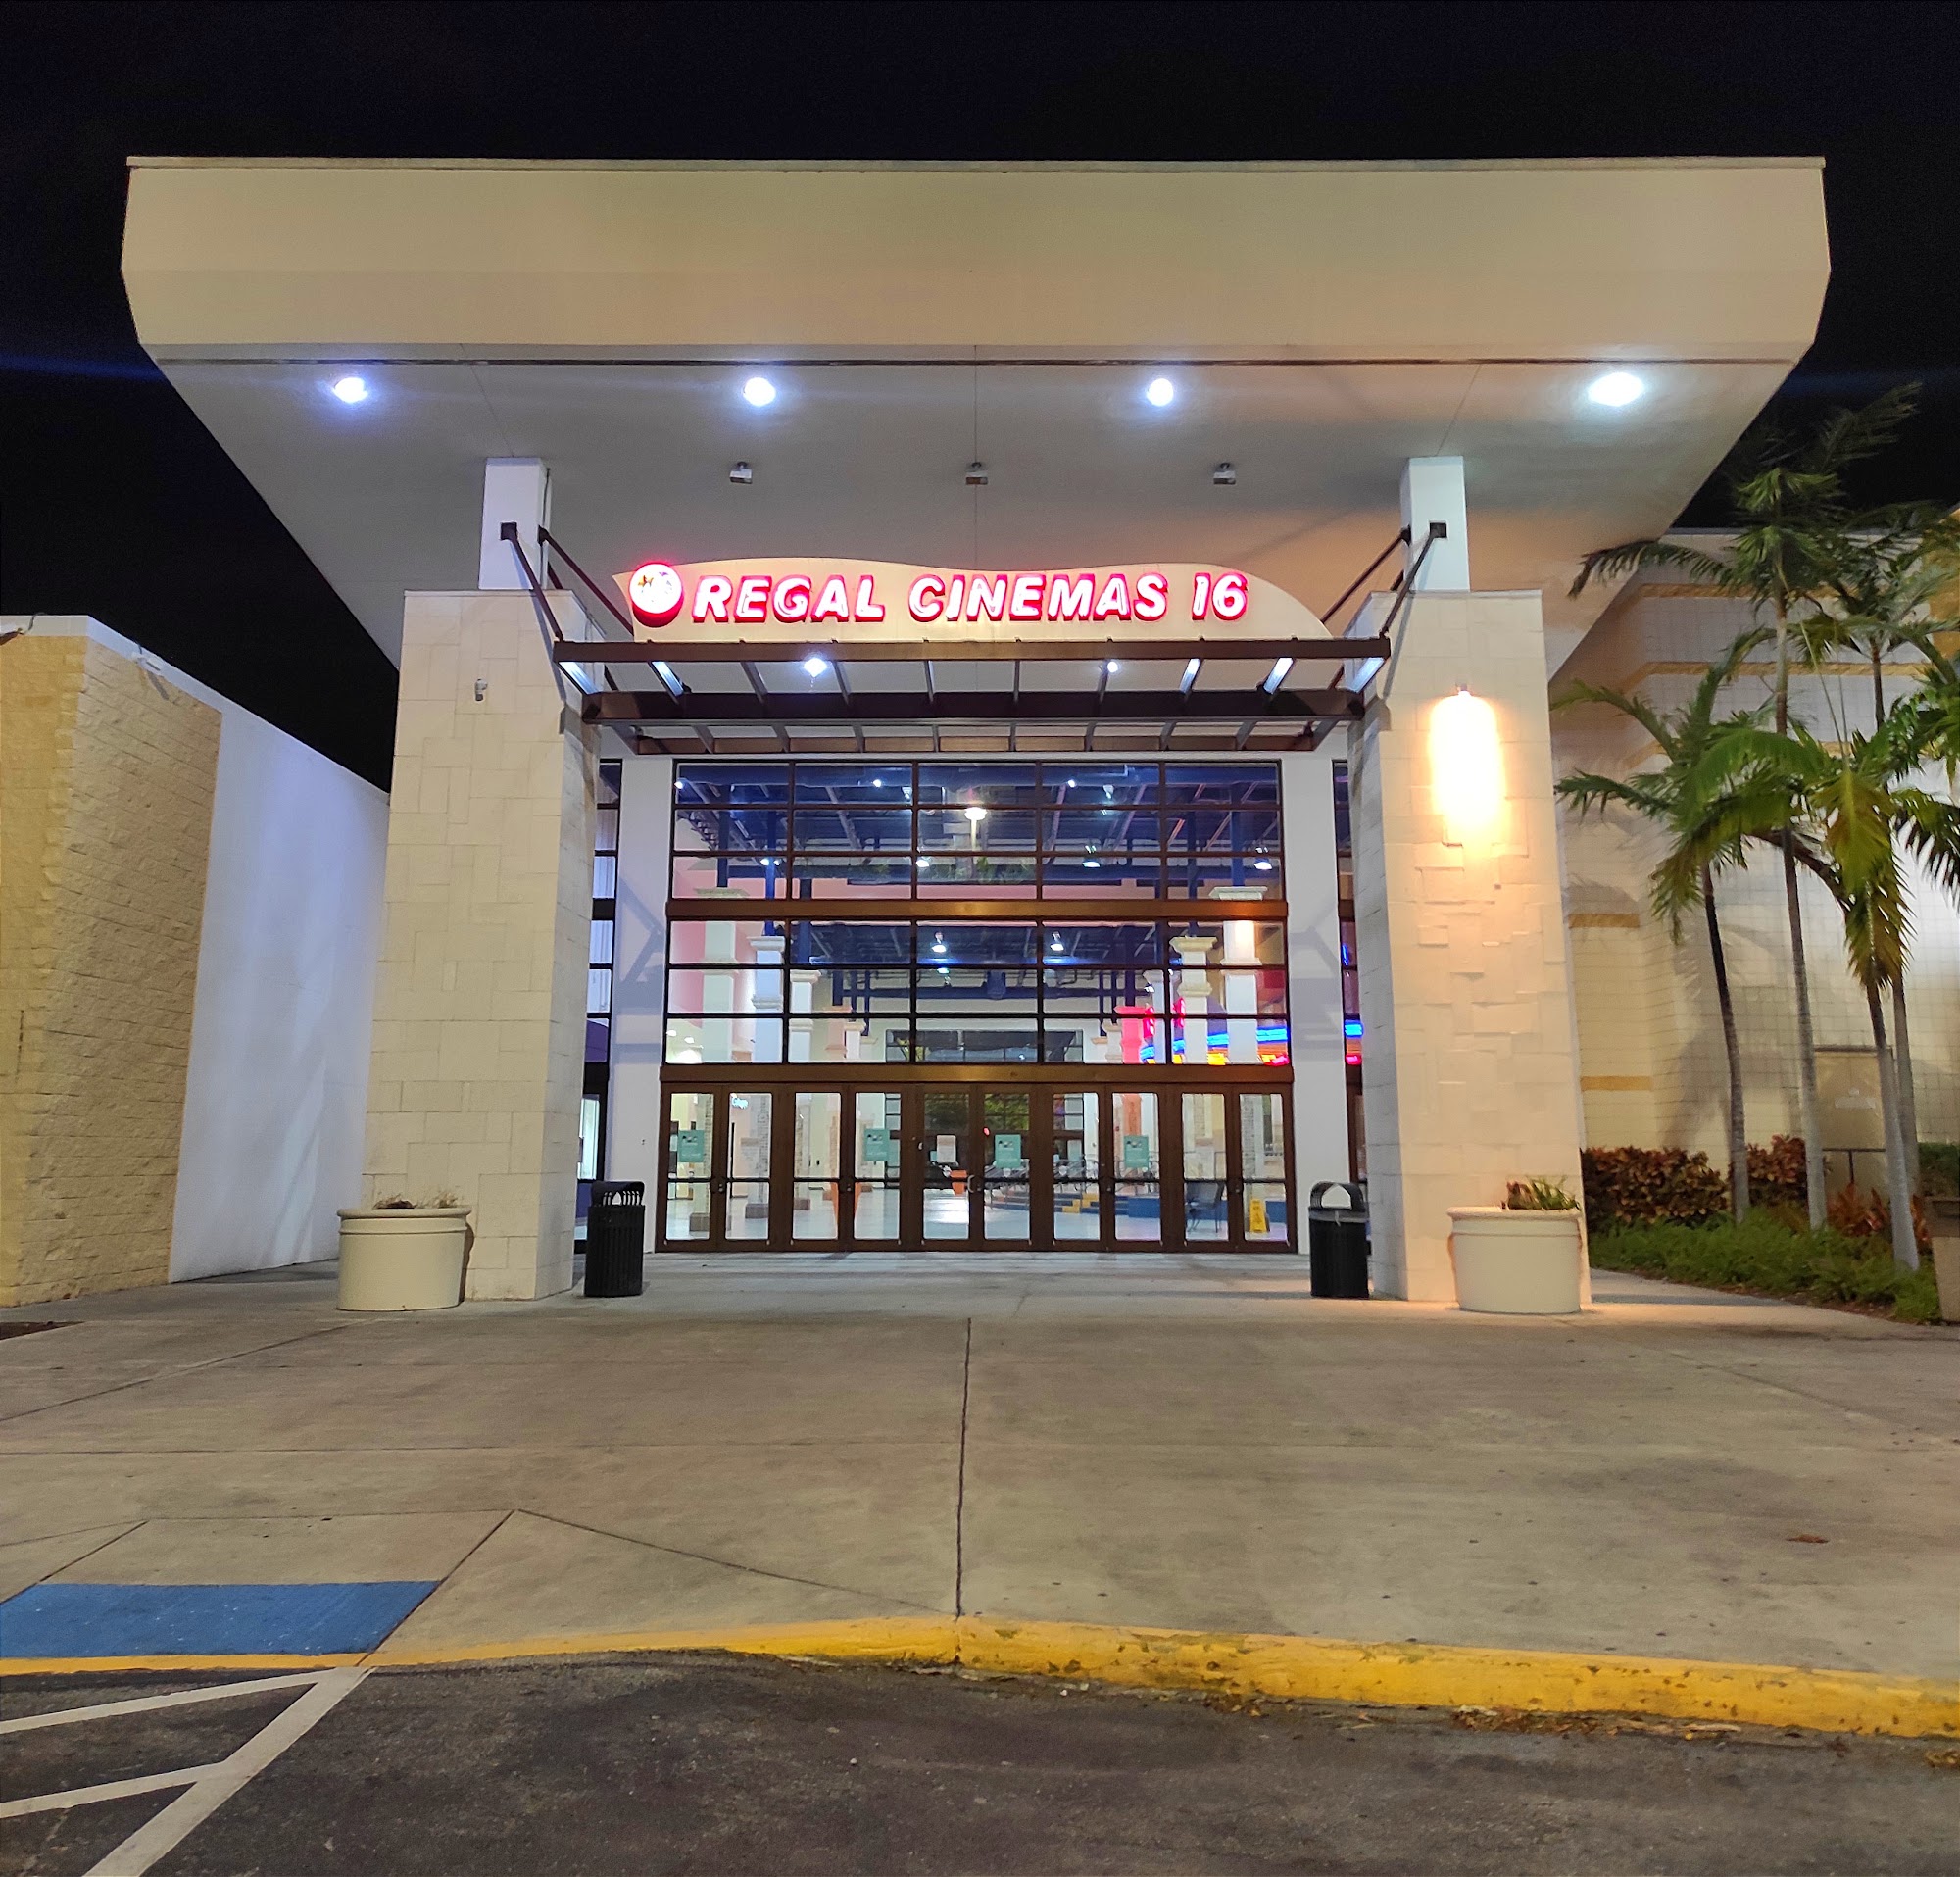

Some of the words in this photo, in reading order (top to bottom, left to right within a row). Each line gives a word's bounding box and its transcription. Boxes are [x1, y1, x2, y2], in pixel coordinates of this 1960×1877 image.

[692, 574, 885, 622] REGAL
[909, 573, 1167, 621] CINEMAS
[1192, 571, 1249, 621] 16
